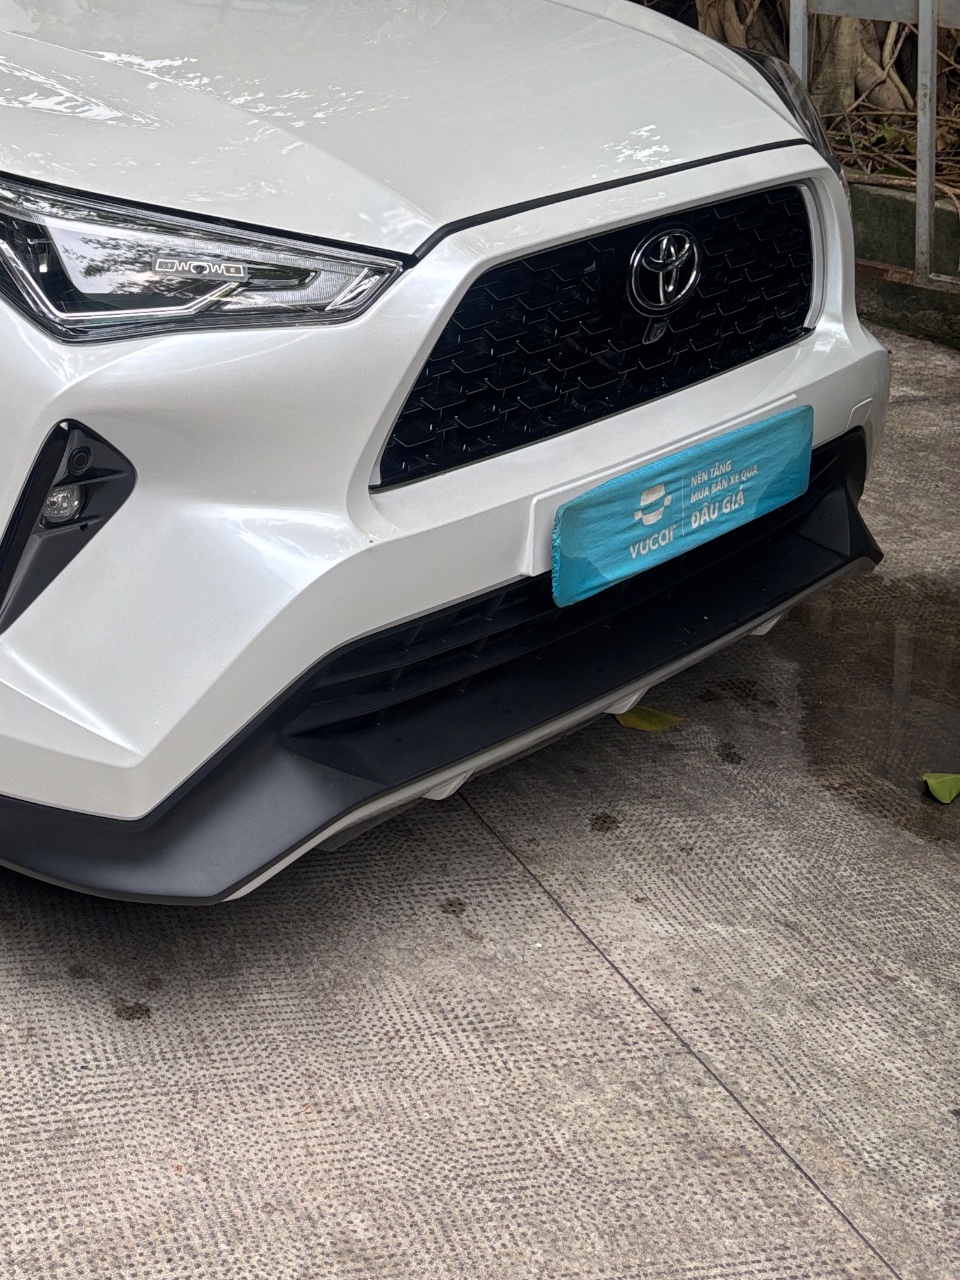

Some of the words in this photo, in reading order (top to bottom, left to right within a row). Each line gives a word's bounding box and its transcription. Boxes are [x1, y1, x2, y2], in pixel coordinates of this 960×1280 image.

[690, 486, 710, 504] MUA
[711, 477, 728, 494] BÁN
[729, 472, 740, 486] XE
[741, 464, 758, 482] QUA
[722, 484, 745, 514] GIÁ
[629, 524, 677, 560] vucar
